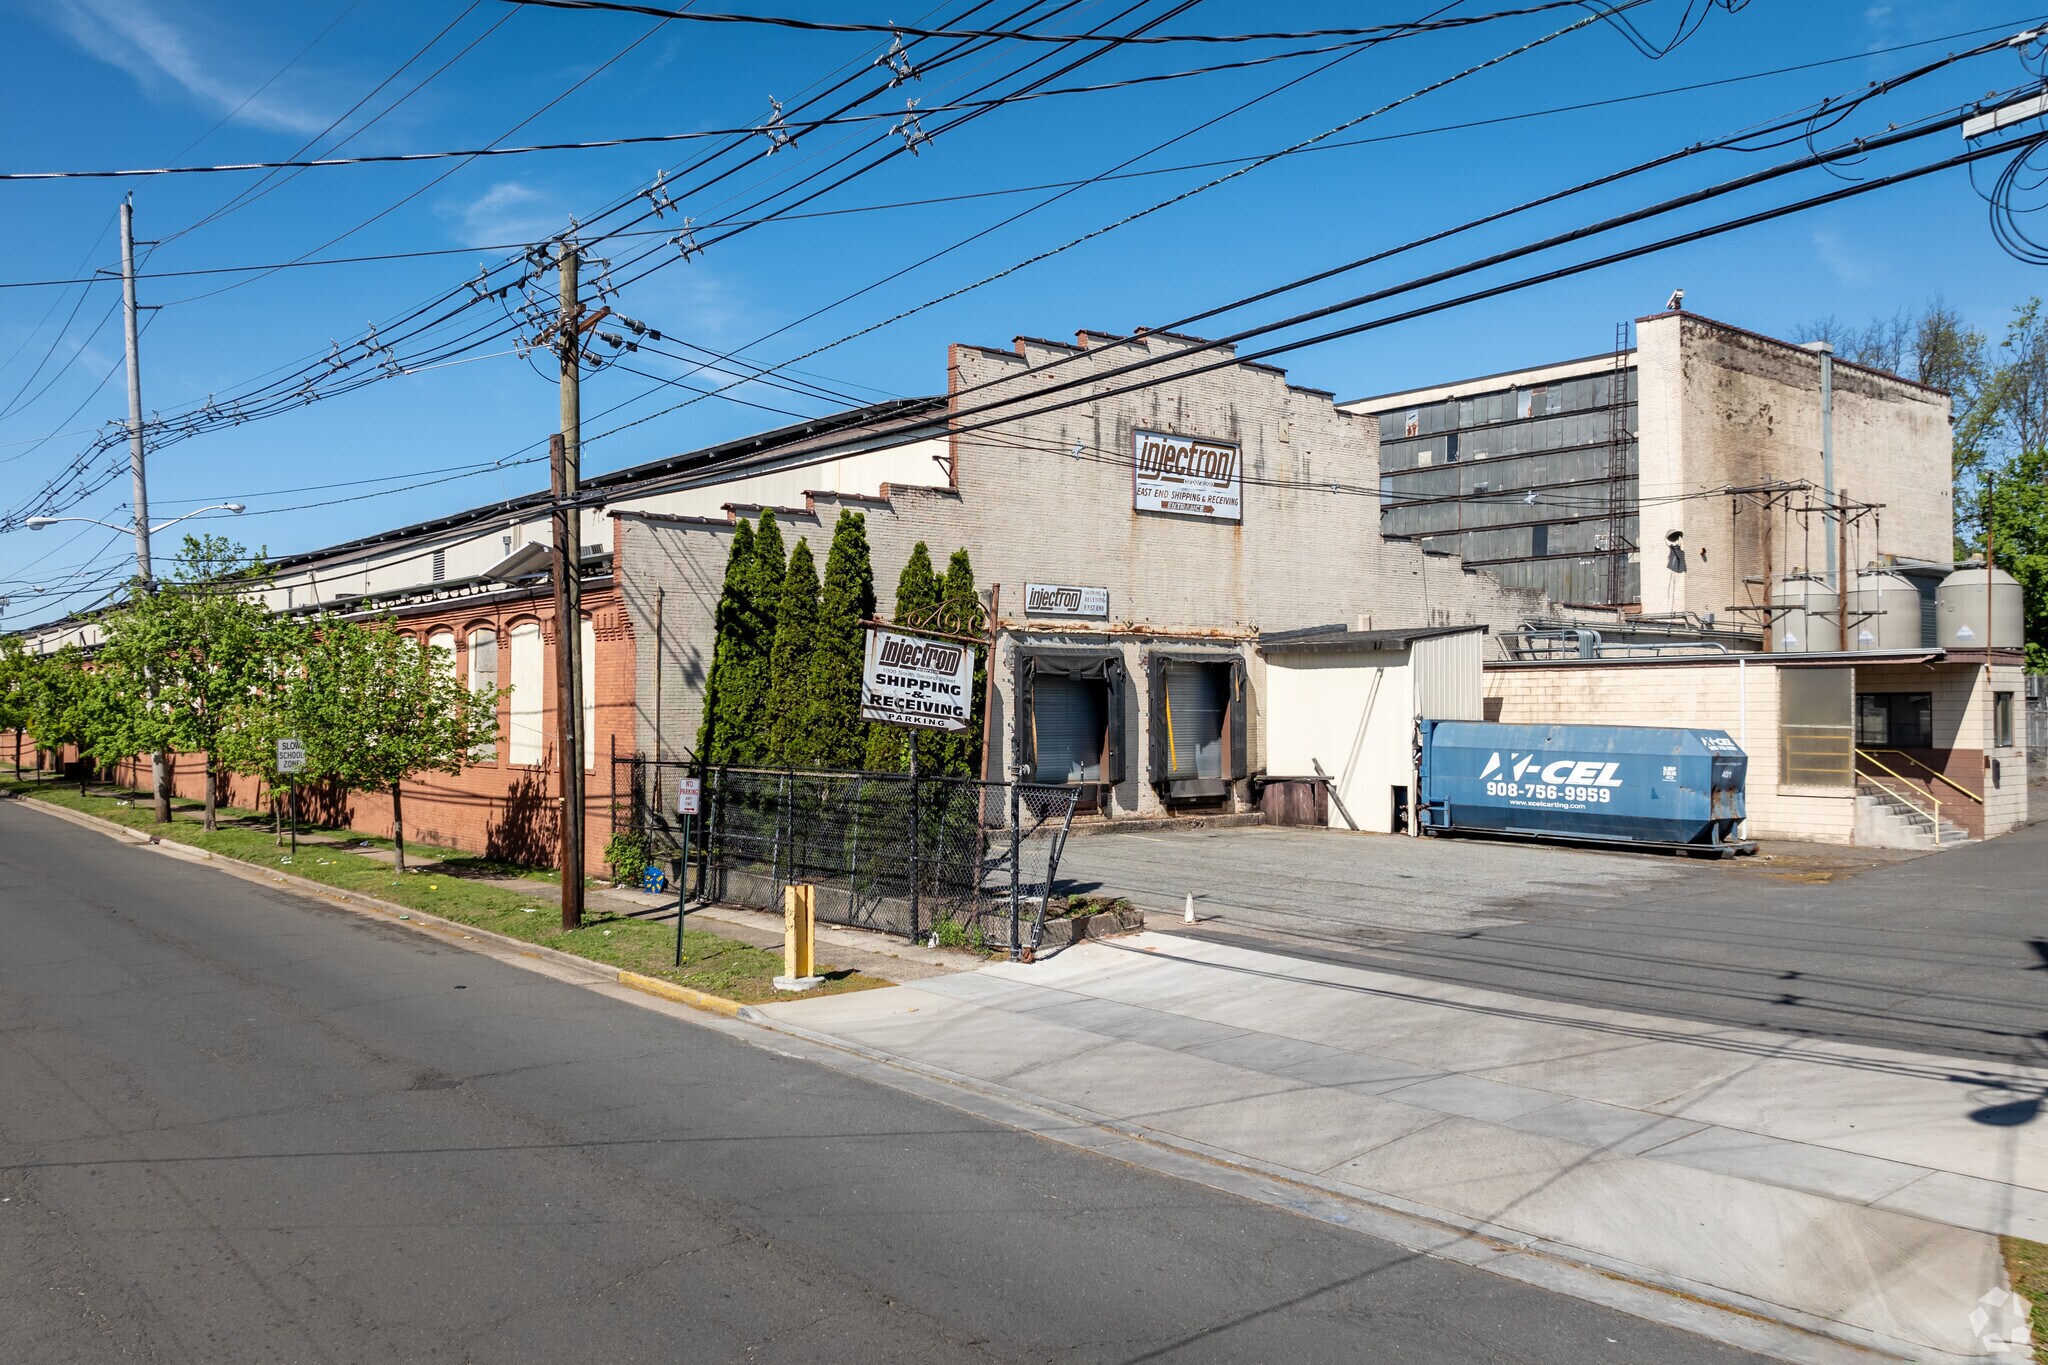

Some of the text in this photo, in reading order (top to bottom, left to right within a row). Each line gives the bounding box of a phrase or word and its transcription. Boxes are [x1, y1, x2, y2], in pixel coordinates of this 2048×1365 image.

[1138, 436, 1236, 484] injectron
[1137, 487, 1152, 497] EAST
[1154, 489, 1169, 499] END
[1171, 491, 1201, 502] SHIPPING
[1208, 495, 1239, 506] RECEIVING
[1168, 501, 1204, 512] ENTRANCE
[1028, 588, 1082, 611] injectron
[879, 636, 962, 676] injectron
[876, 673, 961, 696] SHIPPING
[870, 694, 963, 716] RECEIVING
[888, 713, 945, 726] PARKING
[1700, 737, 1734, 746] X-CEL
[279, 751, 304, 760] SCHOOL
[1479, 751, 1622, 787] X-CEL
[1486, 782, 1610, 803] 908-756-9959
[1510, 799, 1585, 810] www.xcelcarting.com
